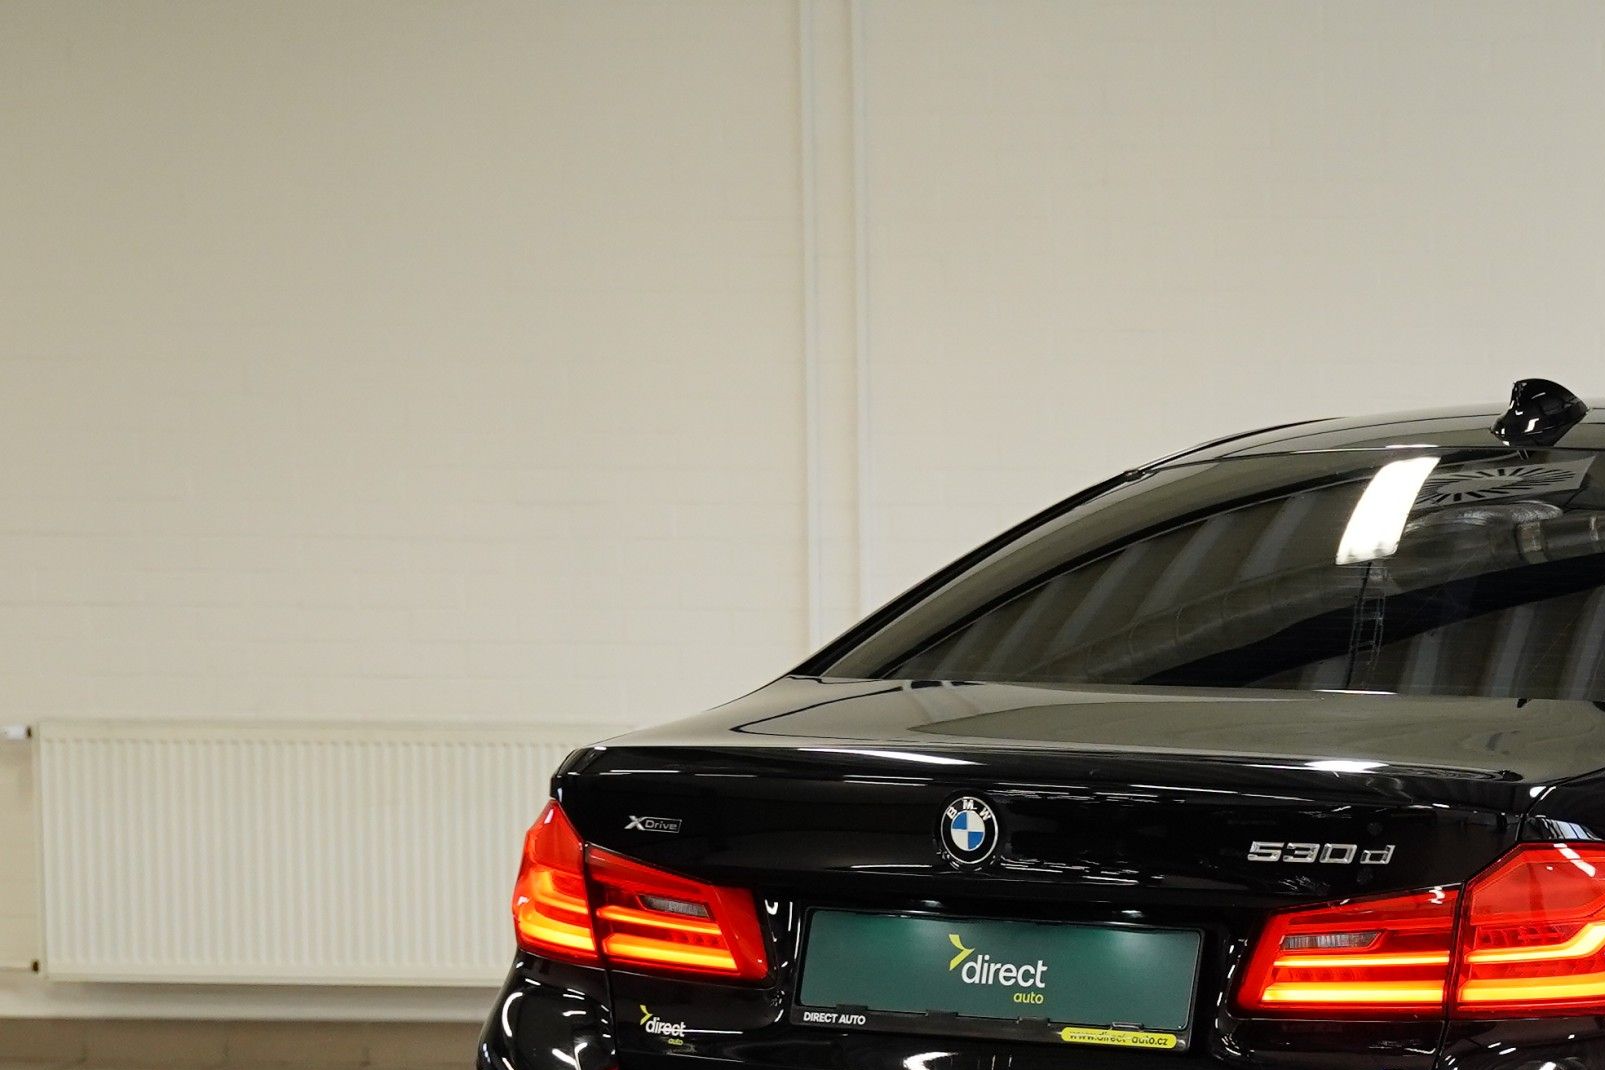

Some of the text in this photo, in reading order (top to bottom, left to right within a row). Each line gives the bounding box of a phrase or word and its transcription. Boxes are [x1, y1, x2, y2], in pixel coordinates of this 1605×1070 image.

[946, 799, 991, 821] BMW
[961, 954, 1048, 988] direct
[1013, 991, 1044, 1004] auto
[645, 1016, 686, 1037] direct
[803, 1011, 866, 1025] DIRECT AUTO
[1069, 1030, 1169, 1046] www.directauto.cz
